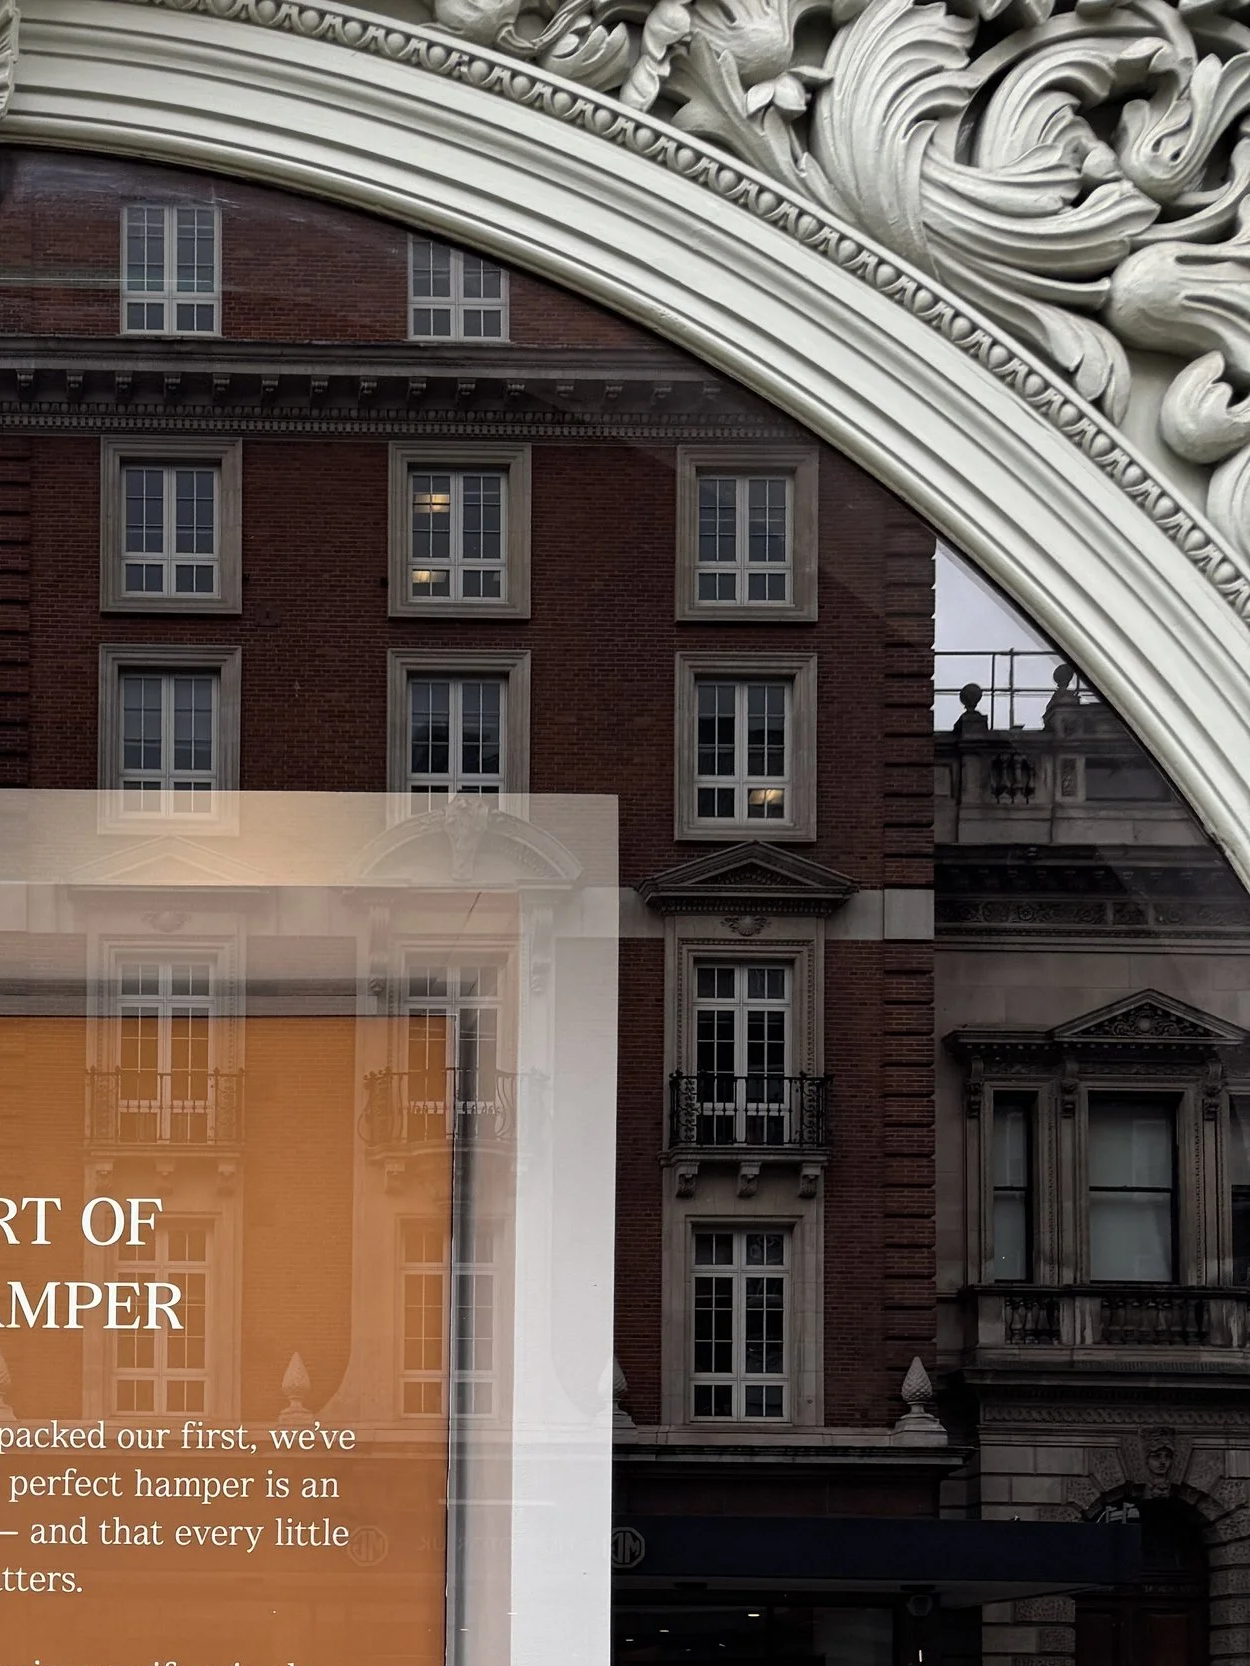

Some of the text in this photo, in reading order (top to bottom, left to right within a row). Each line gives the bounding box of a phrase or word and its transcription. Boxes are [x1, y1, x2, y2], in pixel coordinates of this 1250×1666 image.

[81, 1196, 163, 1246] OF
[117, 1428, 171, 1450] our
[180, 1420, 257, 1454] first,
[8, 1467, 124, 1503] perfect
[134, 1468, 255, 1505] hamper
[265, 1469, 290, 1498] is
[301, 1477, 340, 1498] an
[30, 1515, 89, 1545] and
[98, 1516, 164, 1546] that
[175, 1525, 265, 1553] every
[274, 1517, 349, 1547] little
